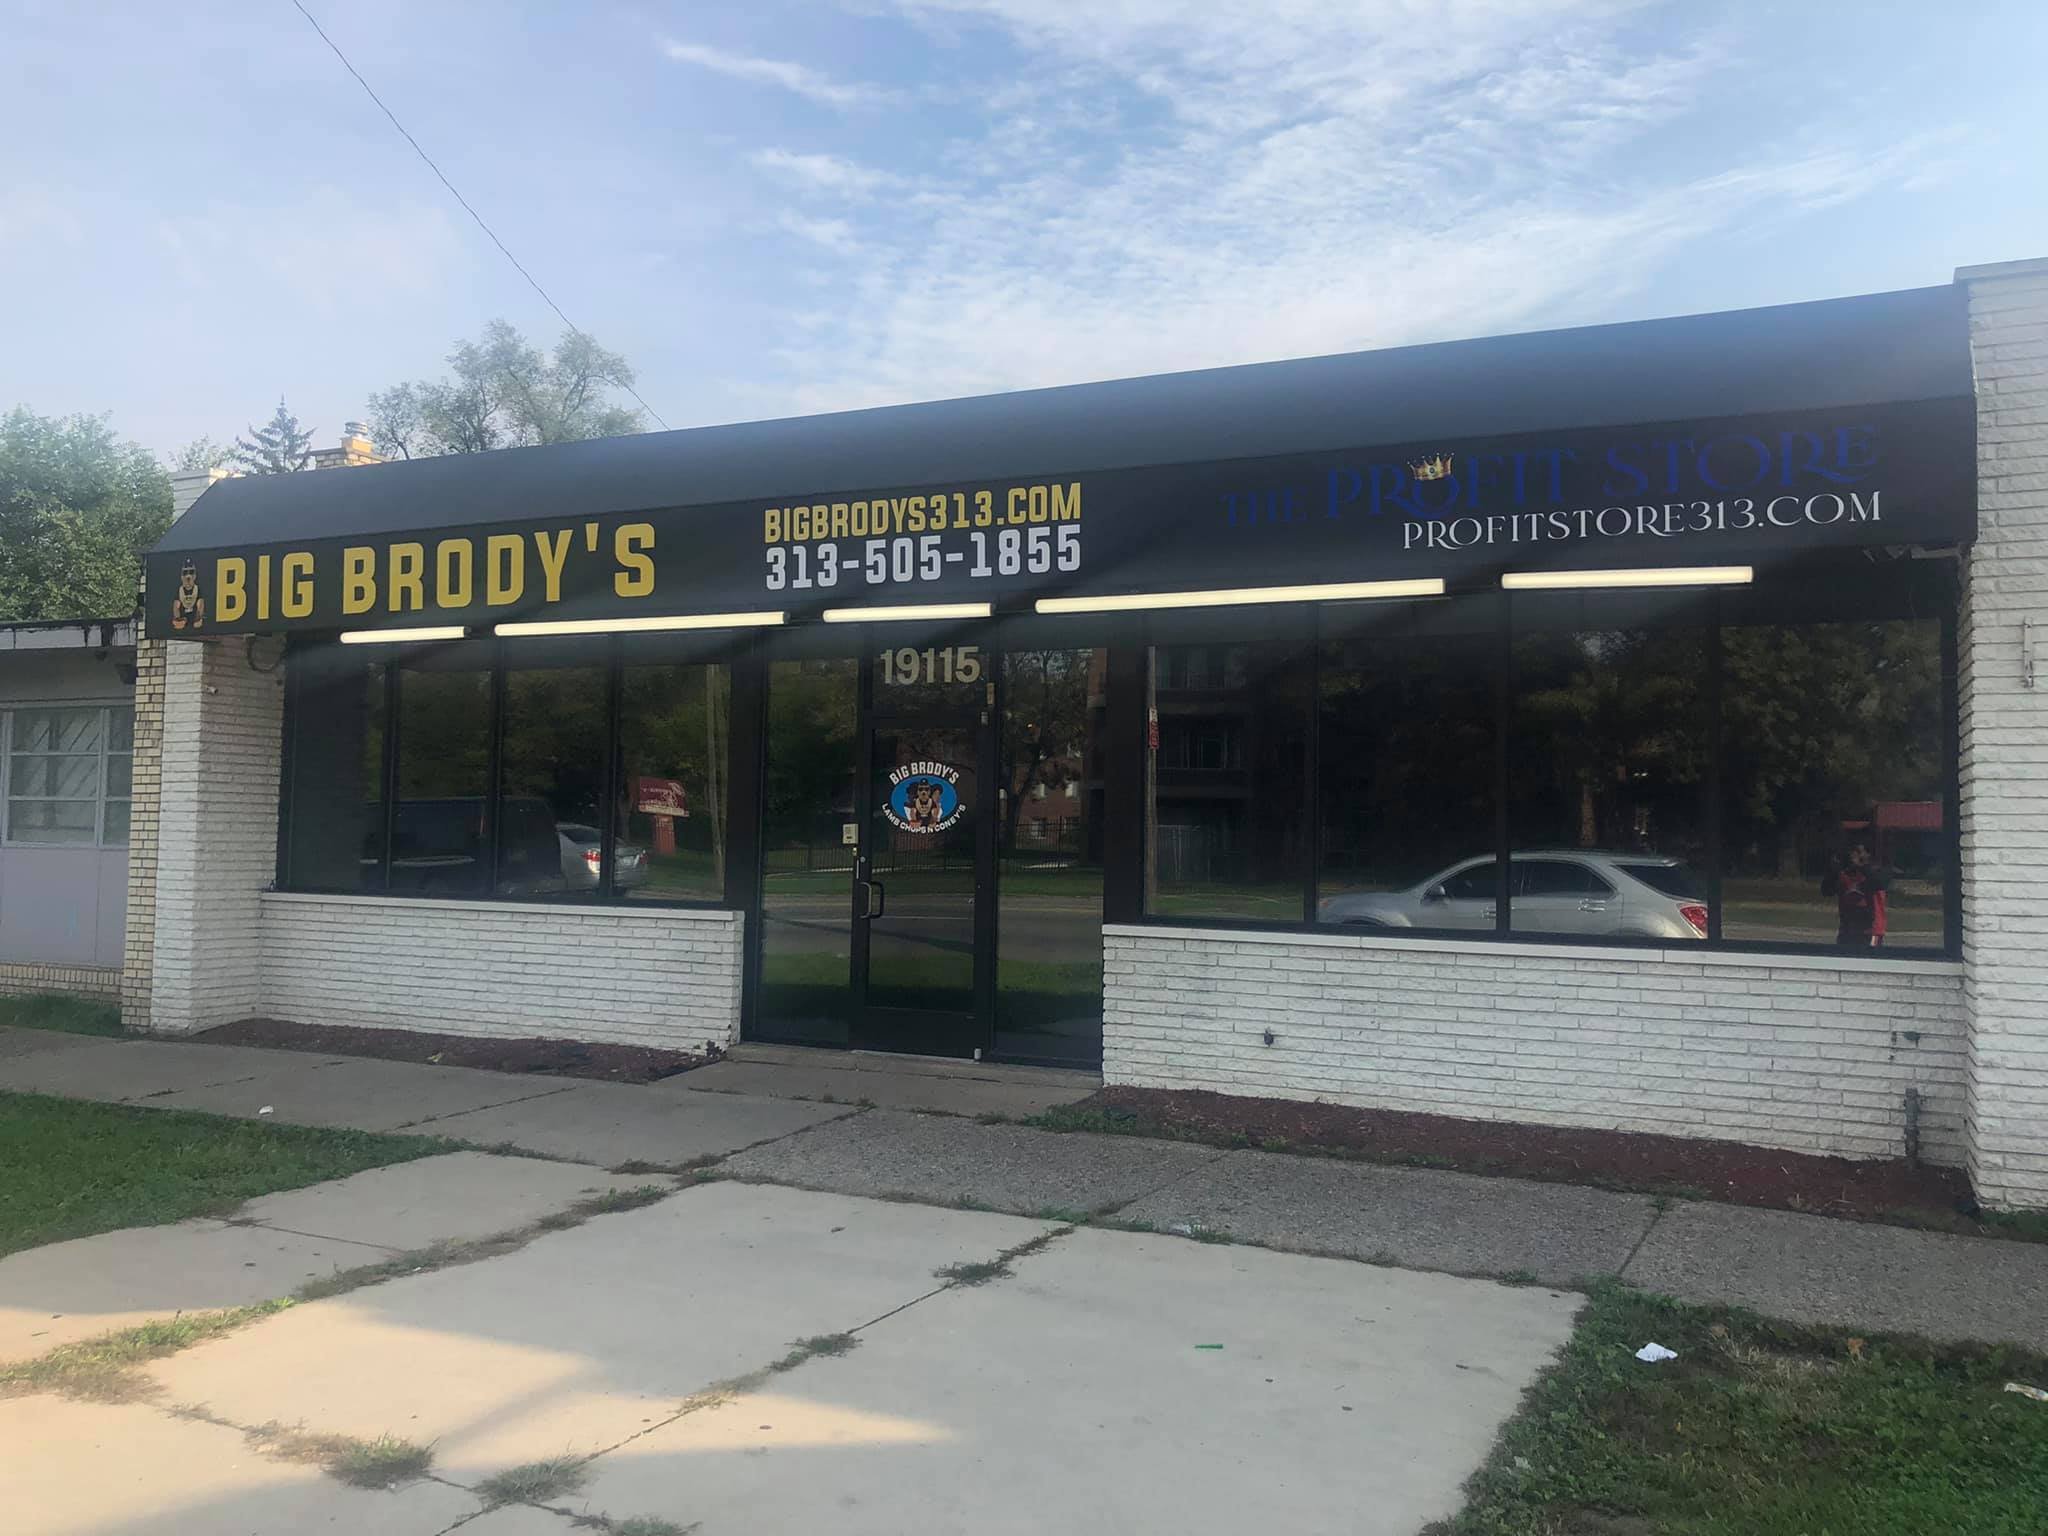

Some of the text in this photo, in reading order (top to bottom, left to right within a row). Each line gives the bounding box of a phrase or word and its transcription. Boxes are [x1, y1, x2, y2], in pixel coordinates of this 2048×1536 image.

[1219, 424, 1884, 528] THE PROFIT STORE
[764, 482, 1081, 543] BIGBRODYS313.COM
[1402, 491, 1881, 550] PROFITSTORE313.COM
[216, 523, 655, 622] BIG BRODY'S
[766, 524, 1081, 590] 313-505-1855
[880, 646, 981, 685] 19115
[889, 761, 960, 785] BIG BRODY'S
[882, 803, 901, 826] LAMB
[935, 804, 966, 832] CONEY'S
